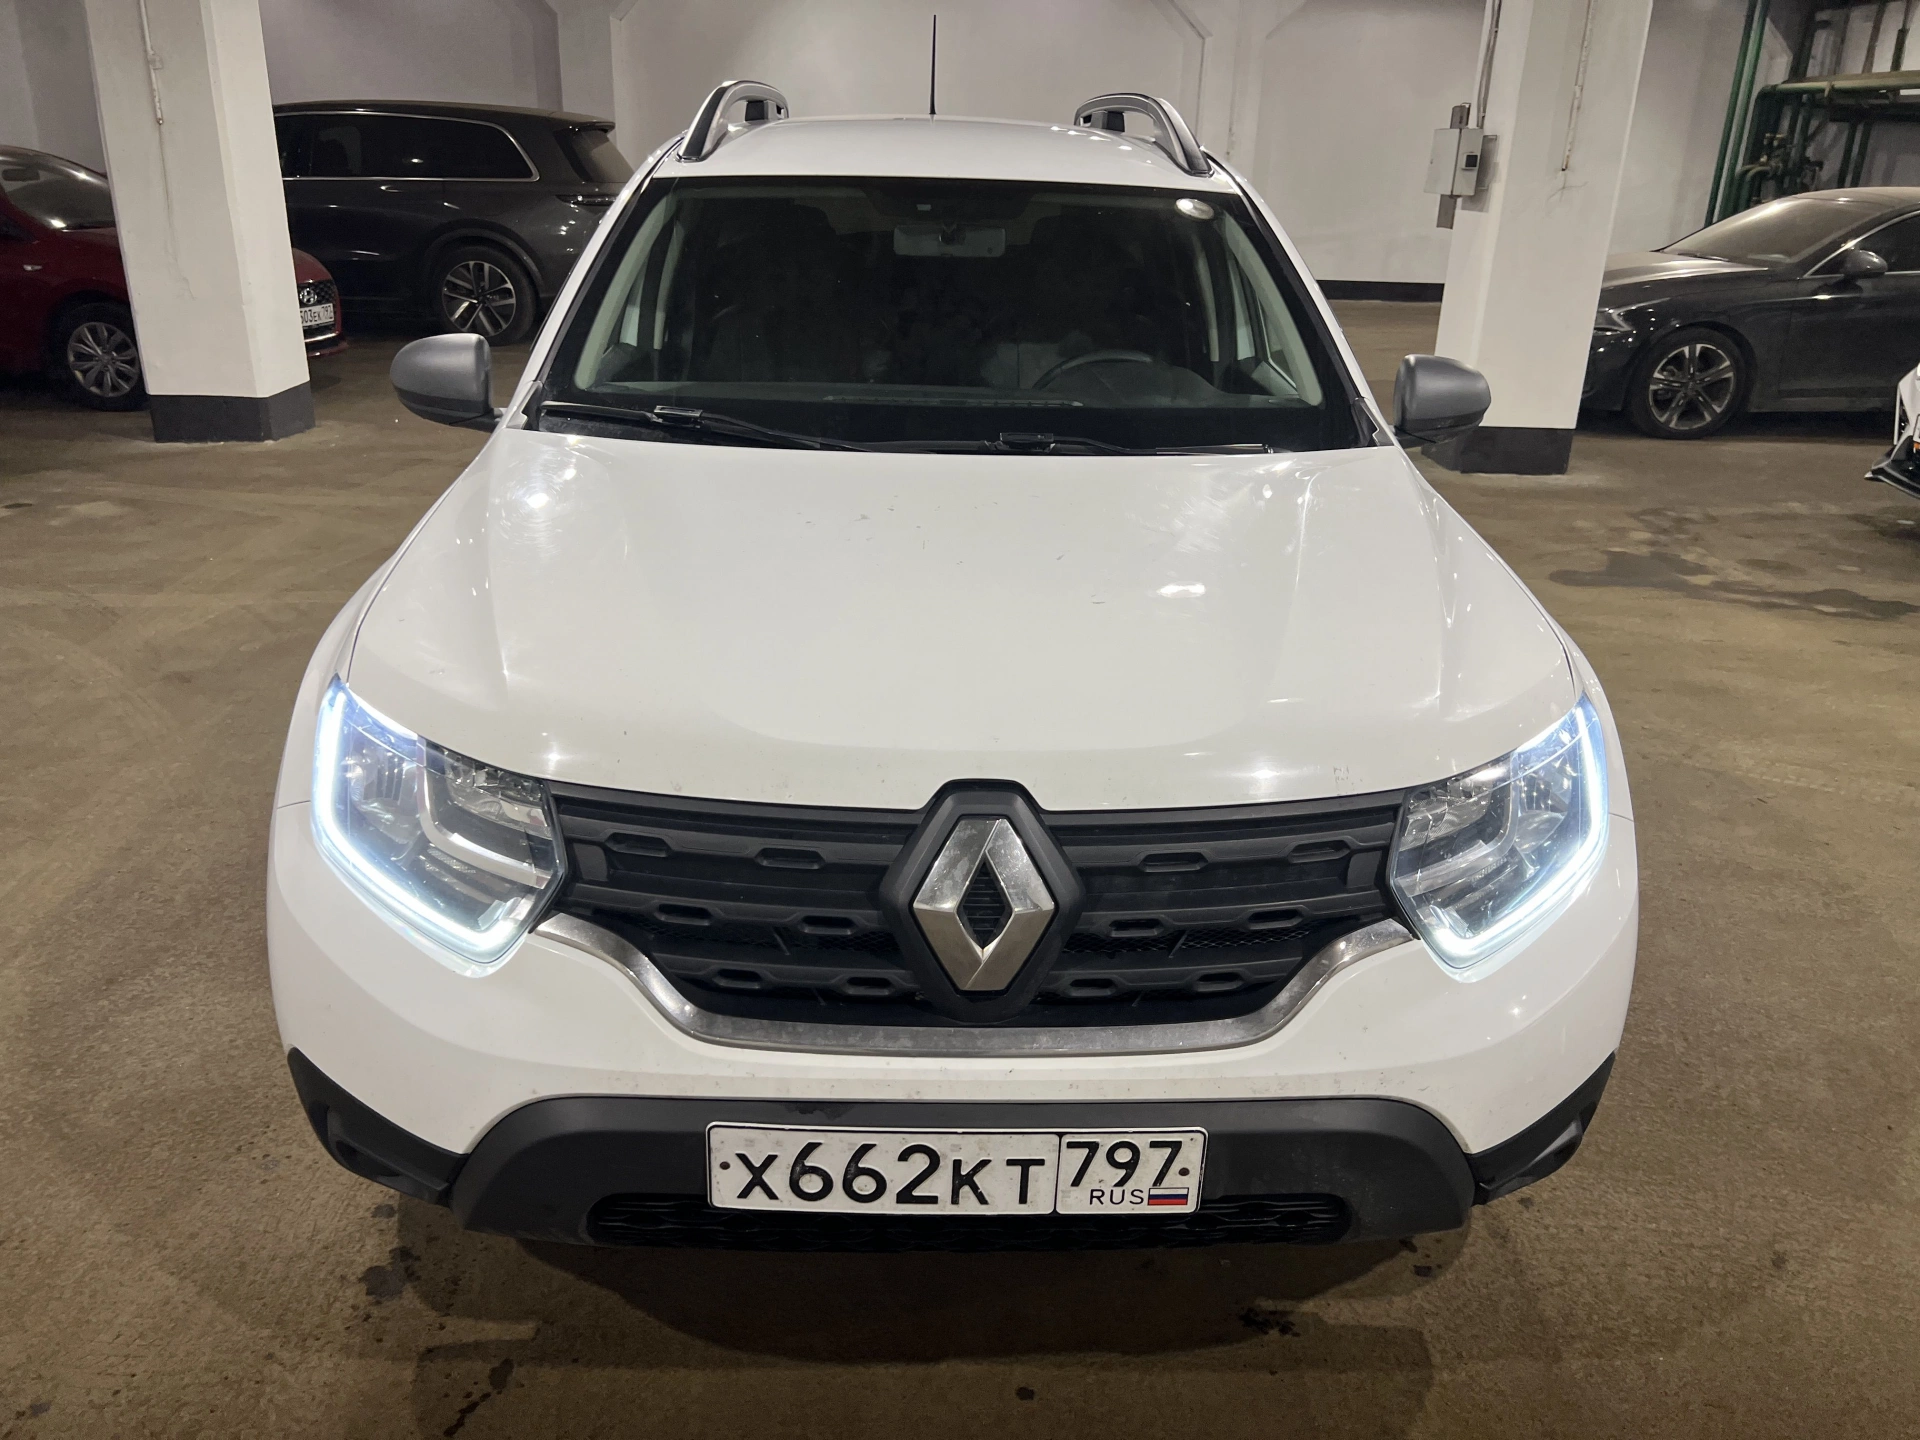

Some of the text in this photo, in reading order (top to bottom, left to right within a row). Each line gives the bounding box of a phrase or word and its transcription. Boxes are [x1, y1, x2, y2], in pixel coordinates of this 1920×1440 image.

[734, 1140, 1183, 1206] Х662КТ 797
[1089, 1188, 1144, 1206] RUS
